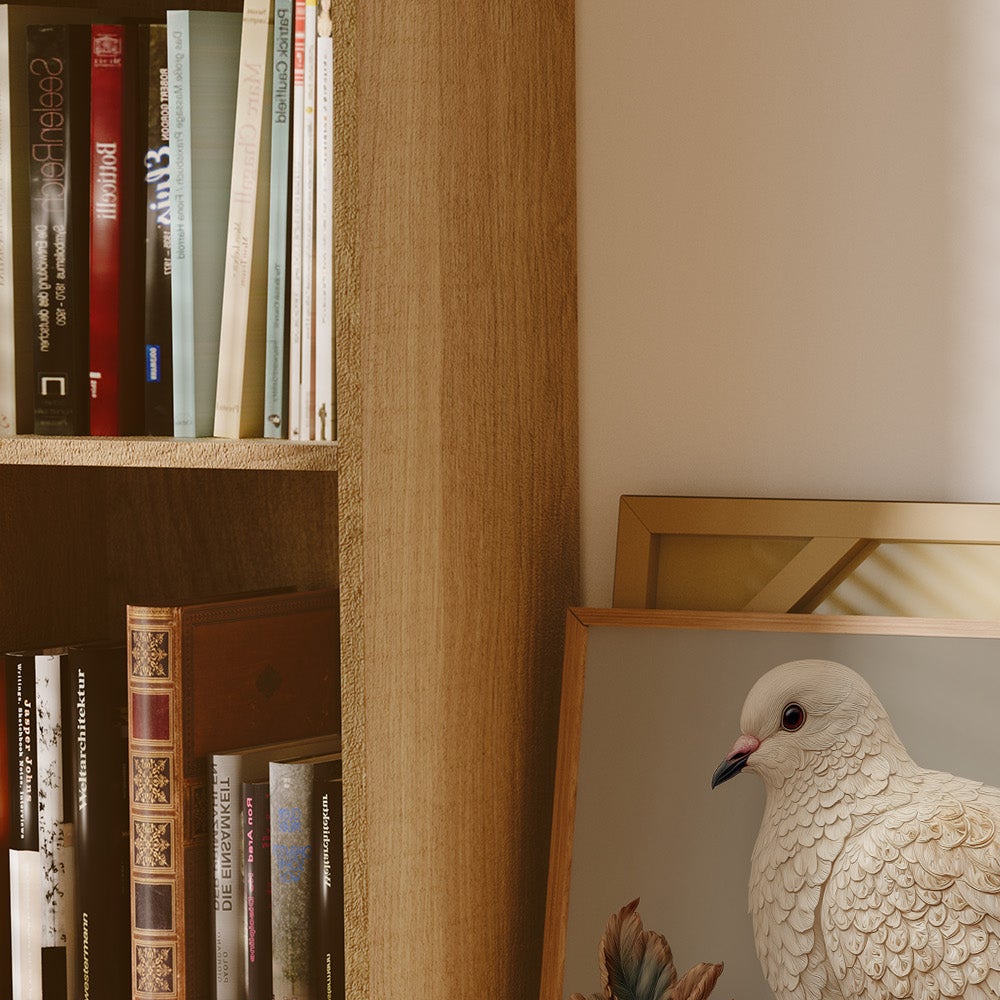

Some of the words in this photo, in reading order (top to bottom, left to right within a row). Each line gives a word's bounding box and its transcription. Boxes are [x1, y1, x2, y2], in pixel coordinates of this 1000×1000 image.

[23, 700, 32, 752] Jasper
[76, 668, 88, 812] Weltarchitektur
[25, 756, 33, 803] Johns
